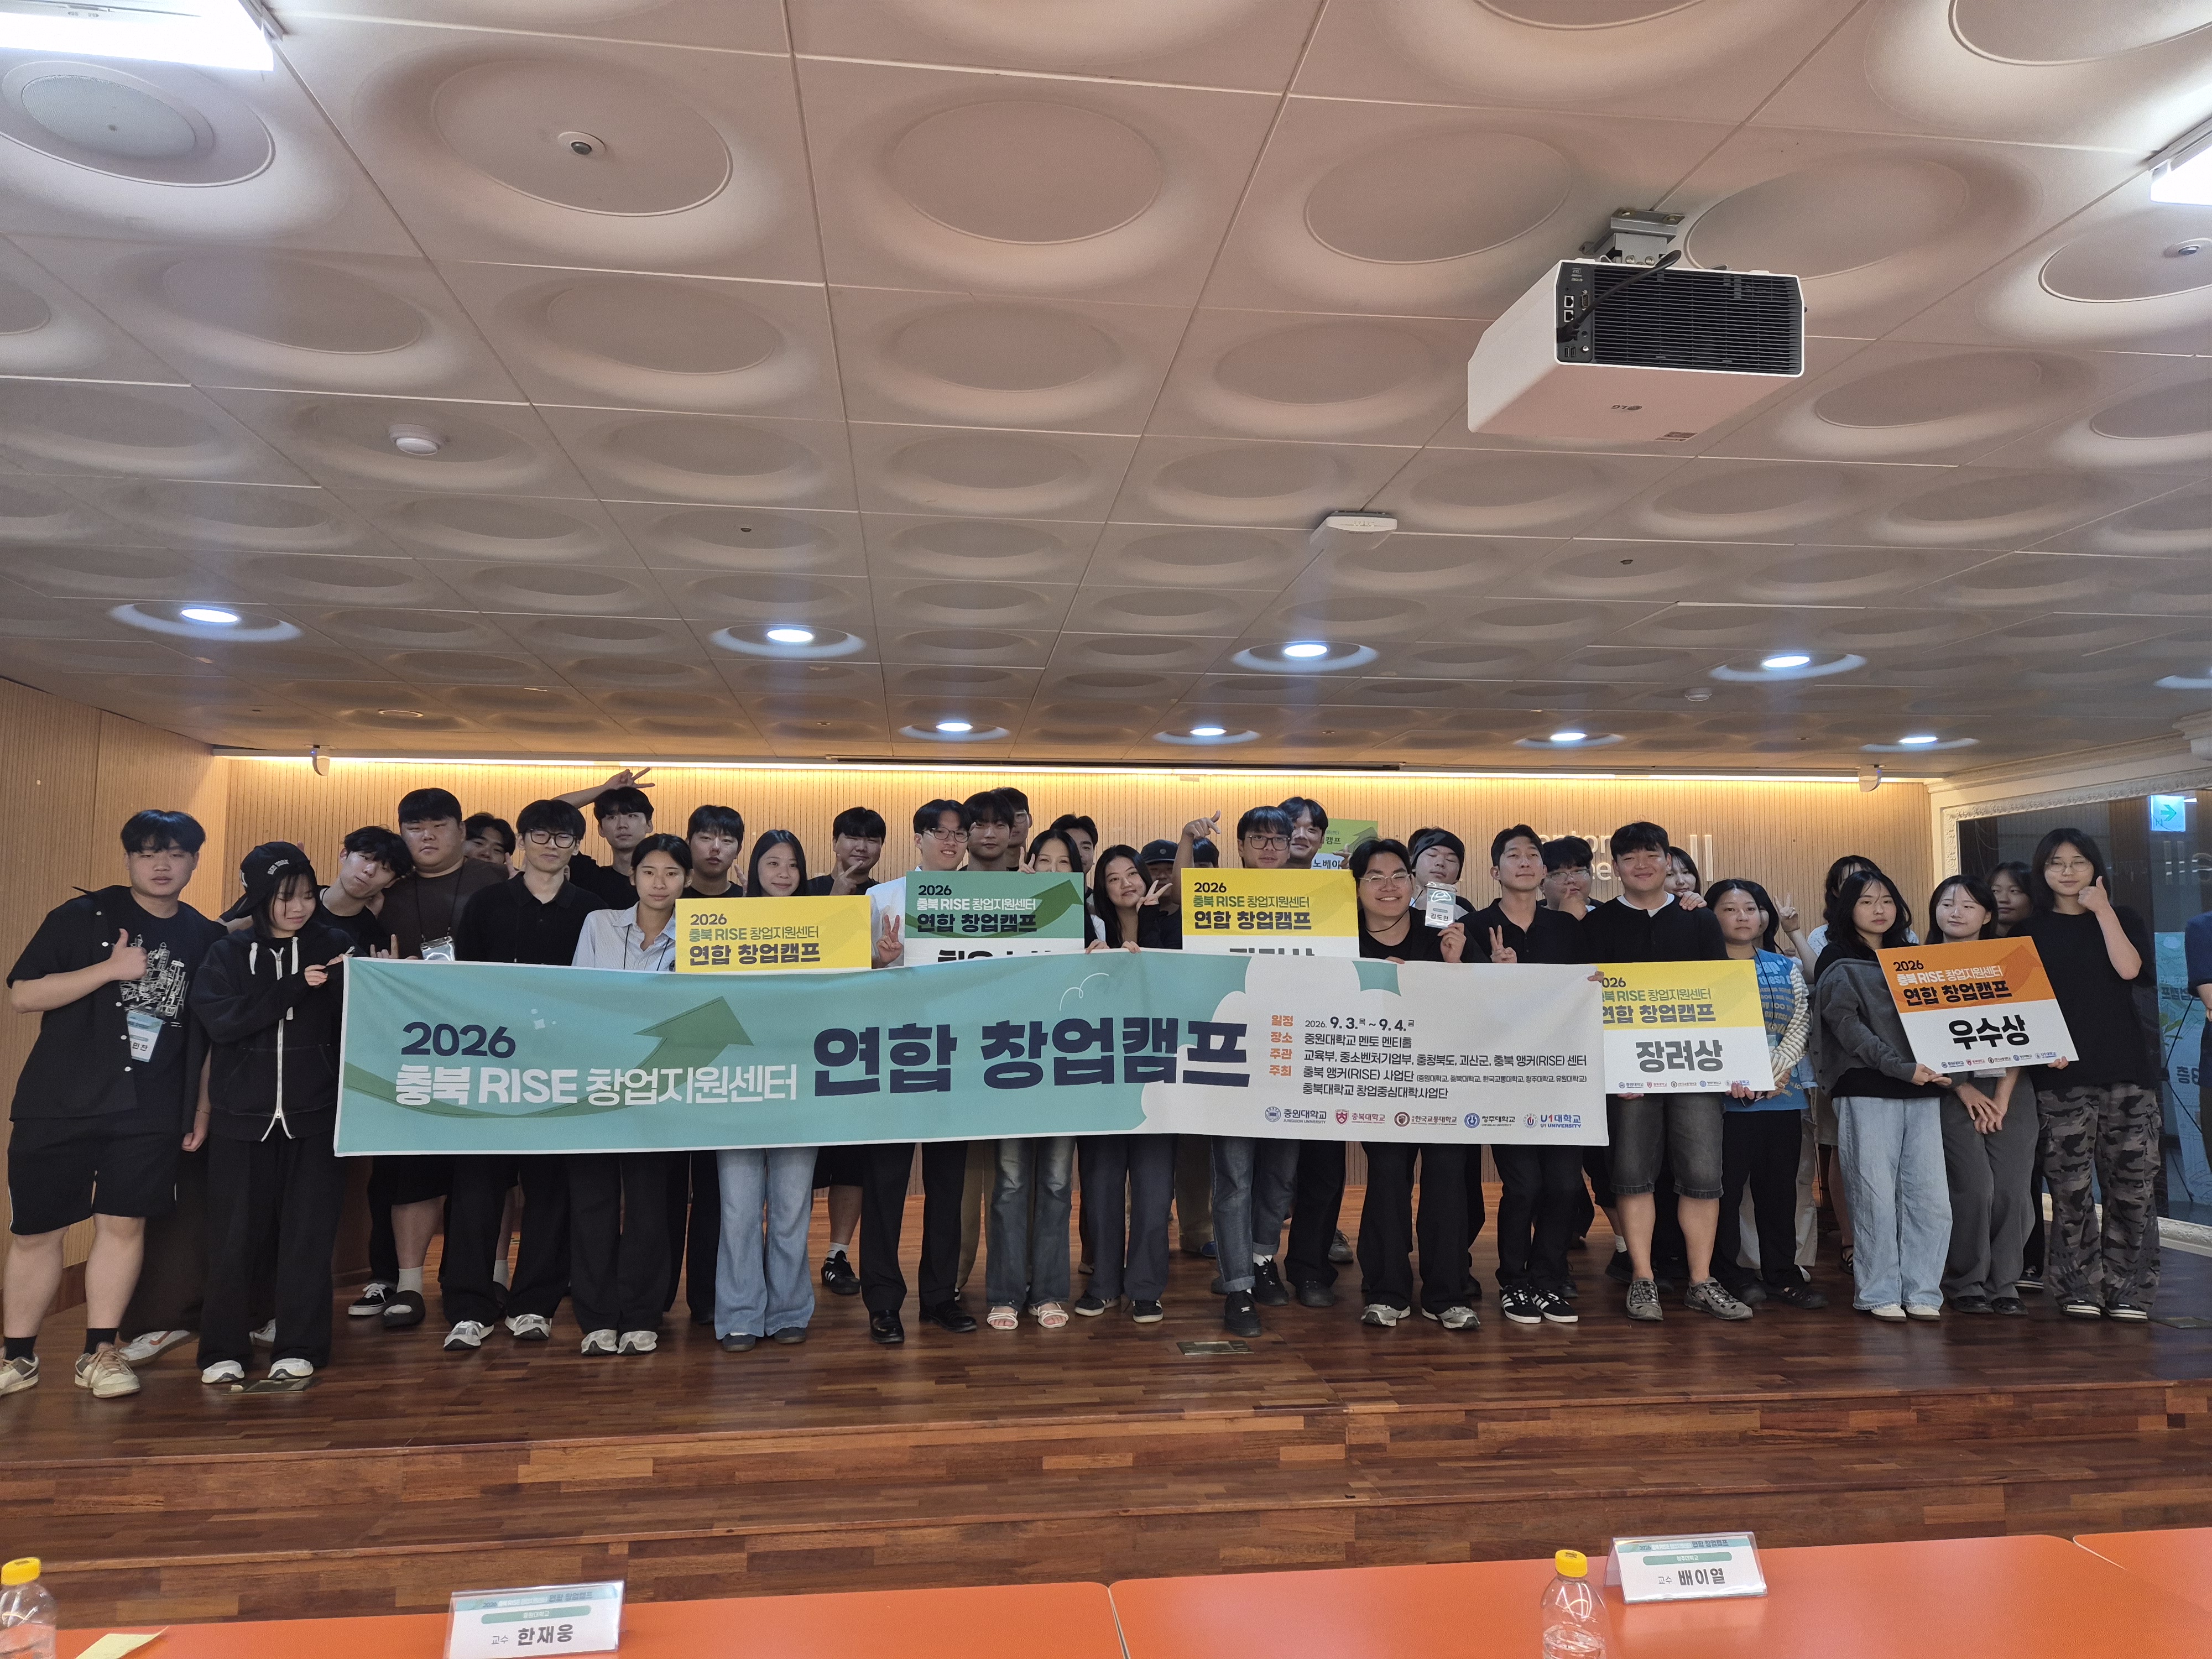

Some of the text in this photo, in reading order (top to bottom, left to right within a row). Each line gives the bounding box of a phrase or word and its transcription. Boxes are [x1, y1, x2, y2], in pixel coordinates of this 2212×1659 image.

[1326, 837, 1341, 845] 캠프
[918, 885, 952, 896] 2026
[1193, 882, 1227, 893] 2026
[916, 898, 1036, 911] 충북 RISE 창업지원센터
[1193, 895, 1310, 908] 충북 RISE 창업지원센터
[690, 913, 727, 926] 2026
[917, 914, 1037, 932] 연합 창업캠프
[1194, 911, 1312, 930] 연합 창업캠프
[689, 925, 819, 942] 충북 RISE 창업지원센터
[690, 943, 821, 966] 연합 창업캠프
[1893, 960, 1924, 972] 2026
[1602, 977, 1626, 988] 026
[1897, 965, 2004, 987] 충북 RISE 창업지원센터
[1602, 988, 1711, 1002] 북 RISE 창업지원센터
[1903, 980, 2012, 1006] 연합 창업캠프
[1271, 1015, 1293, 1027] 일정
[1603, 1004, 1716, 1024] 연합 창업캠프
[401, 1021, 515, 1057] 2026
[1271, 1031, 1293, 1044] 장소
[1949, 1014, 2030, 1050] 우수상
[130, 1041, 148, 1051] 민찬
[1305, 1033, 1412, 1049] 중원대학교 멘토 멘티홀
[813, 1017, 1250, 1097] 연합 창업캠프
[1270, 1048, 1292, 1060] 주관
[1303, 1050, 1587, 1067] 교육부, 중소벤처기업부, 충청북도, 괴산군, 충북 앵커(RISE) 센터
[1635, 1040, 1723, 1073] 장려상
[1269, 1065, 1292, 1077] 주최
[1303, 1066, 1323, 1078] 충북
[1327, 1067, 1380, 1081] 앵커(RISE)
[1383, 1069, 1413, 1082] 사업단
[396, 1064, 797, 1105] 충북 RISE 창업지원센터
[1302, 1083, 1448, 1099] 충북대학교 창업중심대학사업단
[1284, 1109, 1327, 1119] 중원대학교
[1352, 1113, 1385, 1121] 충북대학교
[1541, 1114, 1581, 1123] U1대학교
[1658, 1568, 1725, 1585] 교수 배이열
[491, 1624, 573, 1646] 교수 한재웅
